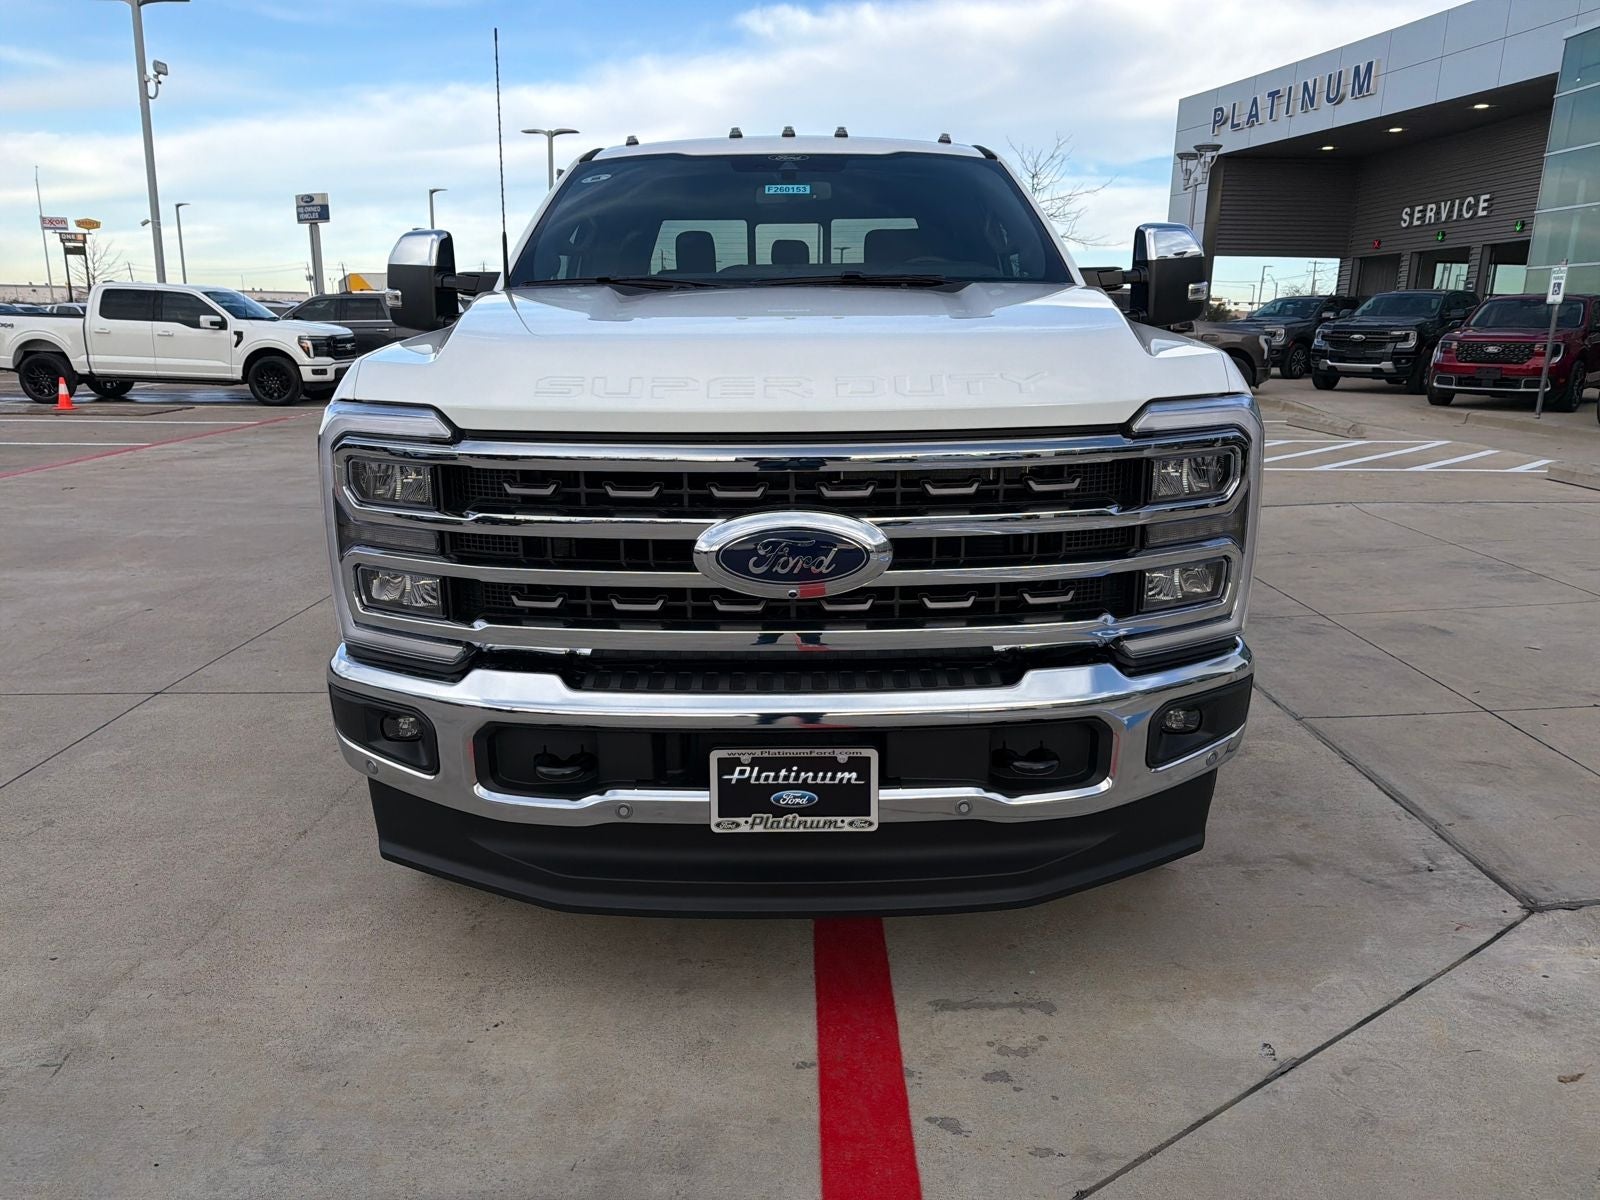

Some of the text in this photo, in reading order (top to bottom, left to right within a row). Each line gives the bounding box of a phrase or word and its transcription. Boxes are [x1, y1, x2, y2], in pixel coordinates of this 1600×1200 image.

[1211, 59, 1378, 136] PLATINUM
[42, 218, 66, 227] Exxon
[1401, 194, 1490, 228] SERVICE
[534, 370, 1049, 399] SUPER DUTY
[748, 538, 839, 574] Ford
[722, 766, 865, 784] Platinum
[779, 792, 808, 805] Ford
[718, 813, 870, 830] Ford Platinum Ford
